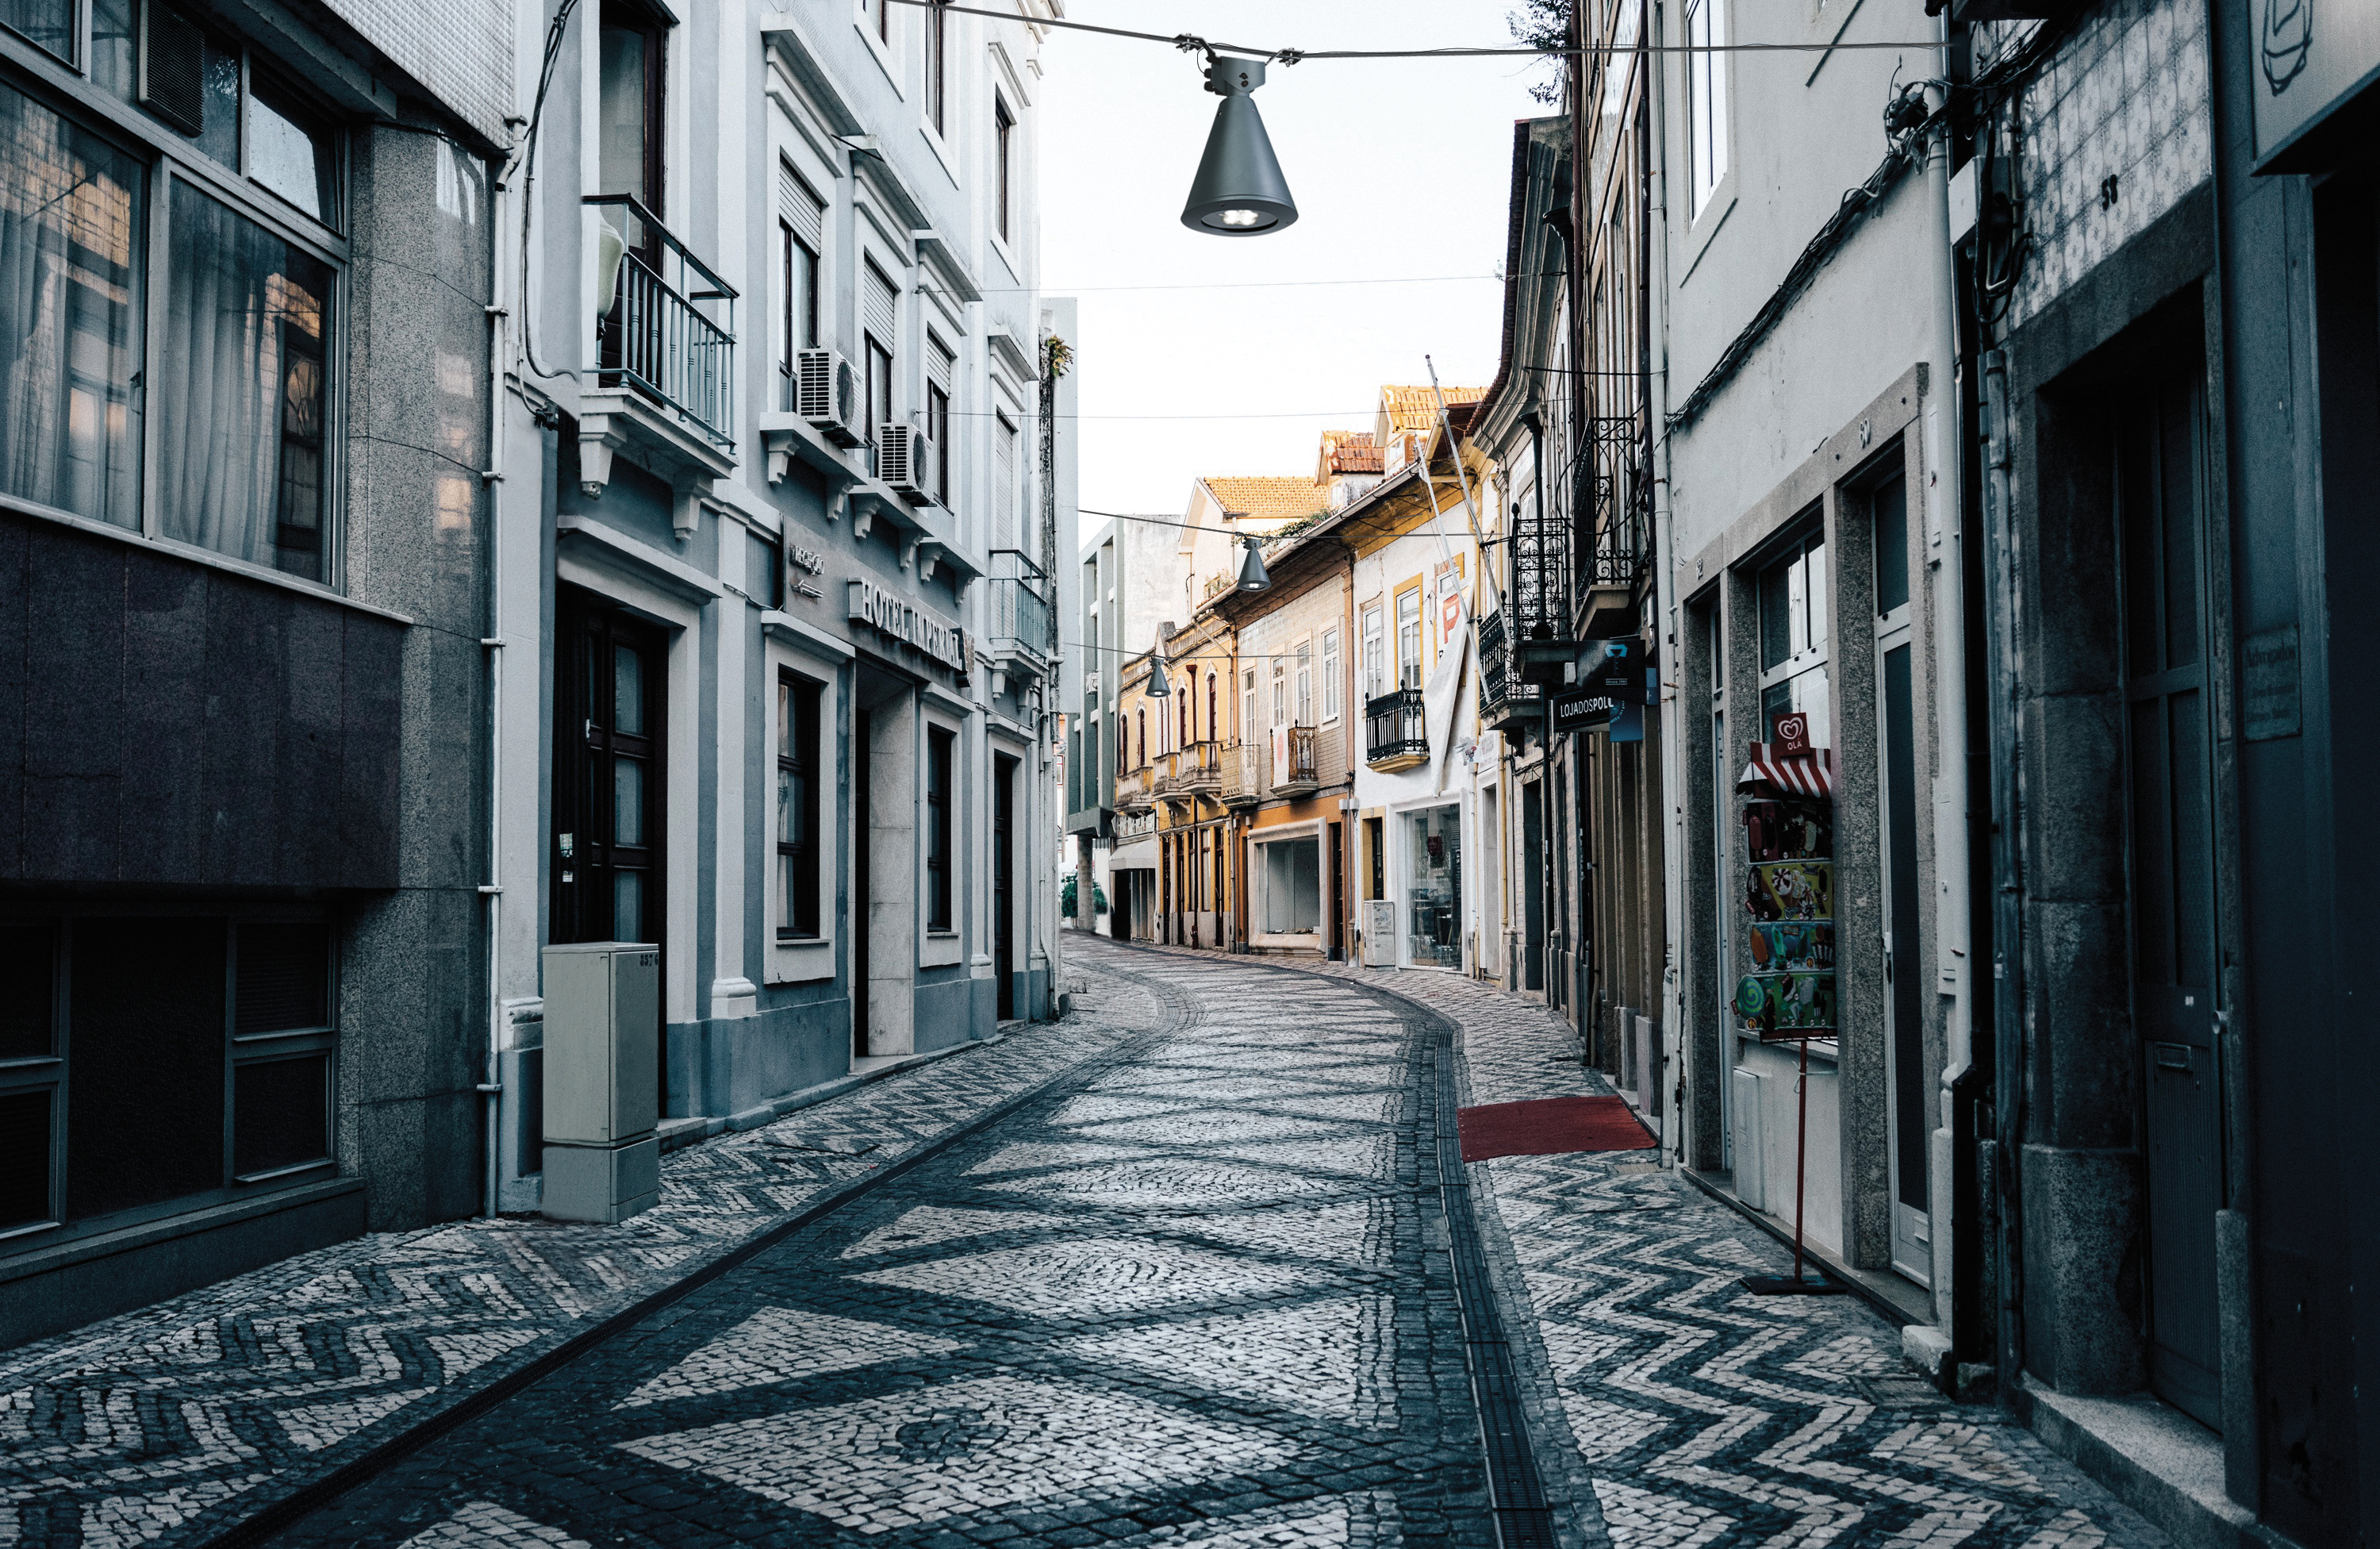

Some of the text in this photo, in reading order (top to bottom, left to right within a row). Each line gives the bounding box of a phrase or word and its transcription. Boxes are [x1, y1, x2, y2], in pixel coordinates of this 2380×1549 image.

[2102, 174, 2118, 211] 58
[861, 577, 963, 671] HOTEL IMPERIAL
